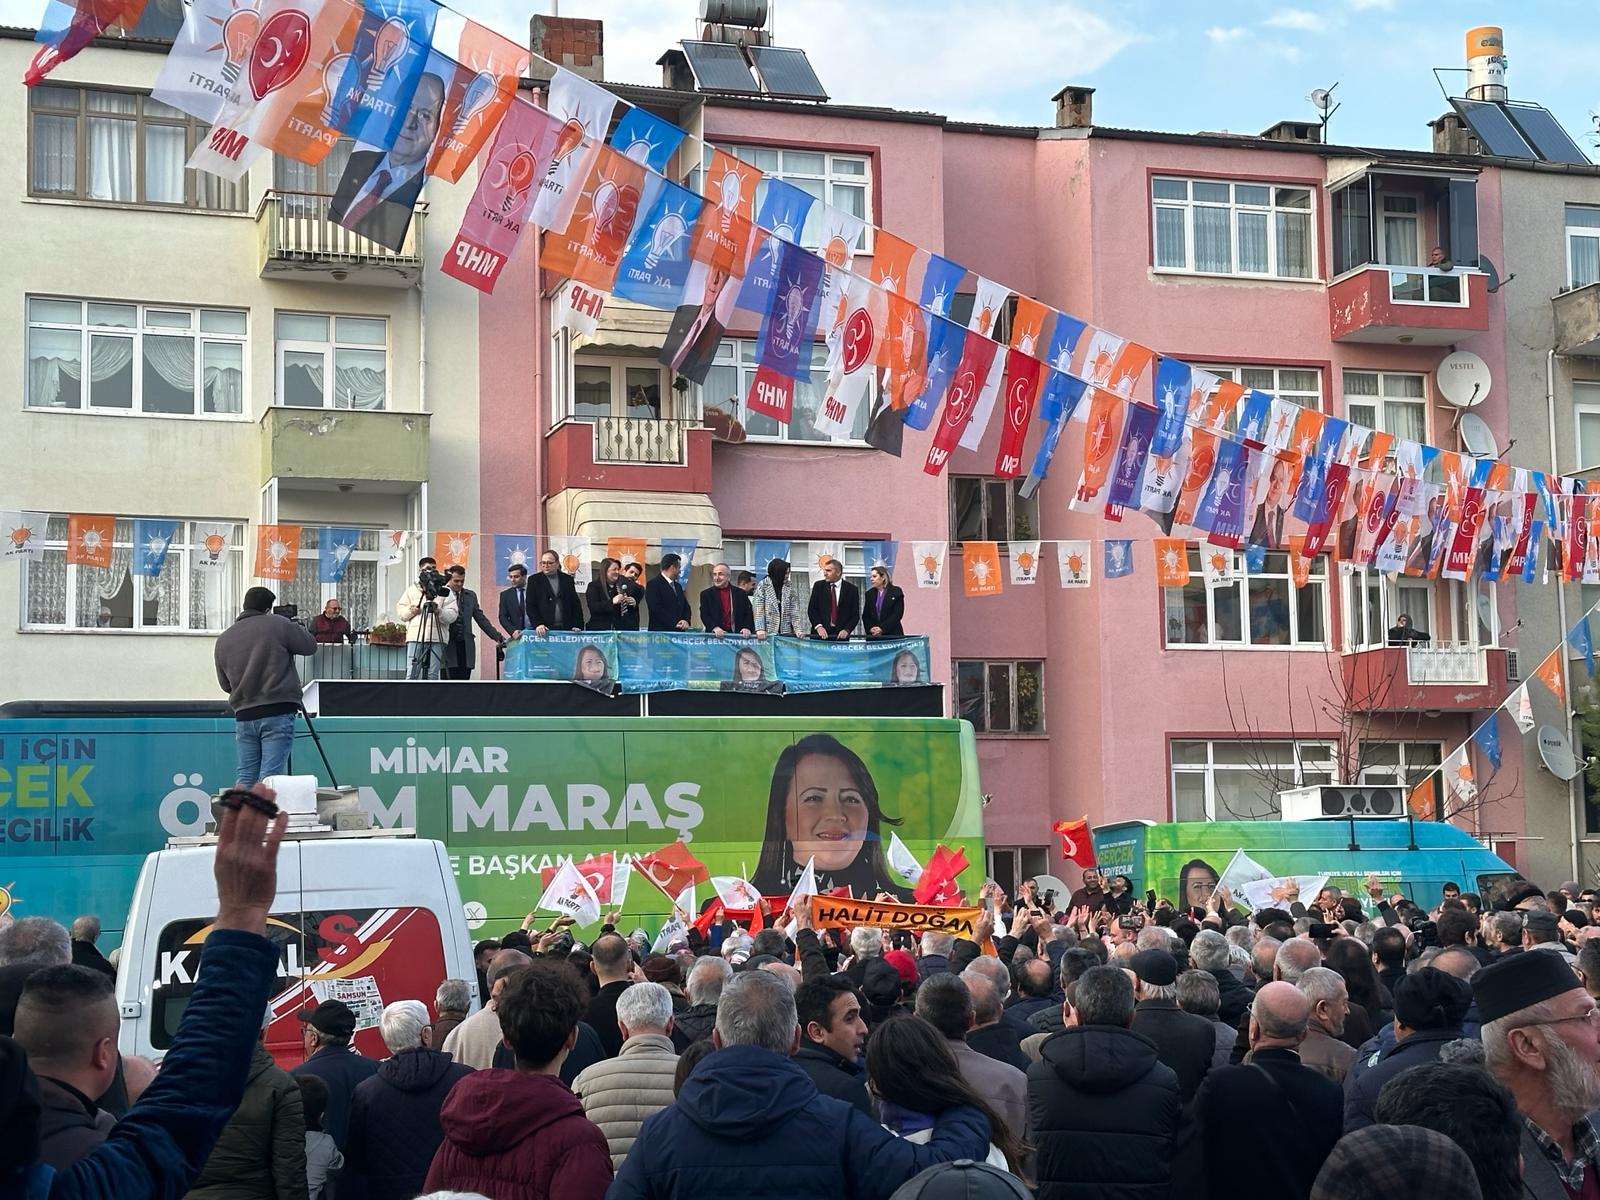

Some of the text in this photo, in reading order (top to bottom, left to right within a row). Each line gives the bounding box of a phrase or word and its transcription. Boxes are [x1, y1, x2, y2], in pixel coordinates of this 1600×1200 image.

[706, 229, 719, 242] AK
[20, 737, 96, 764] İÇİN
[370, 737, 509, 774] MİMAR
[451, 782, 705, 843] MARAŞ
[818, 907, 891, 922] HALİT
[337, 992, 366, 1000] SAMSUN
